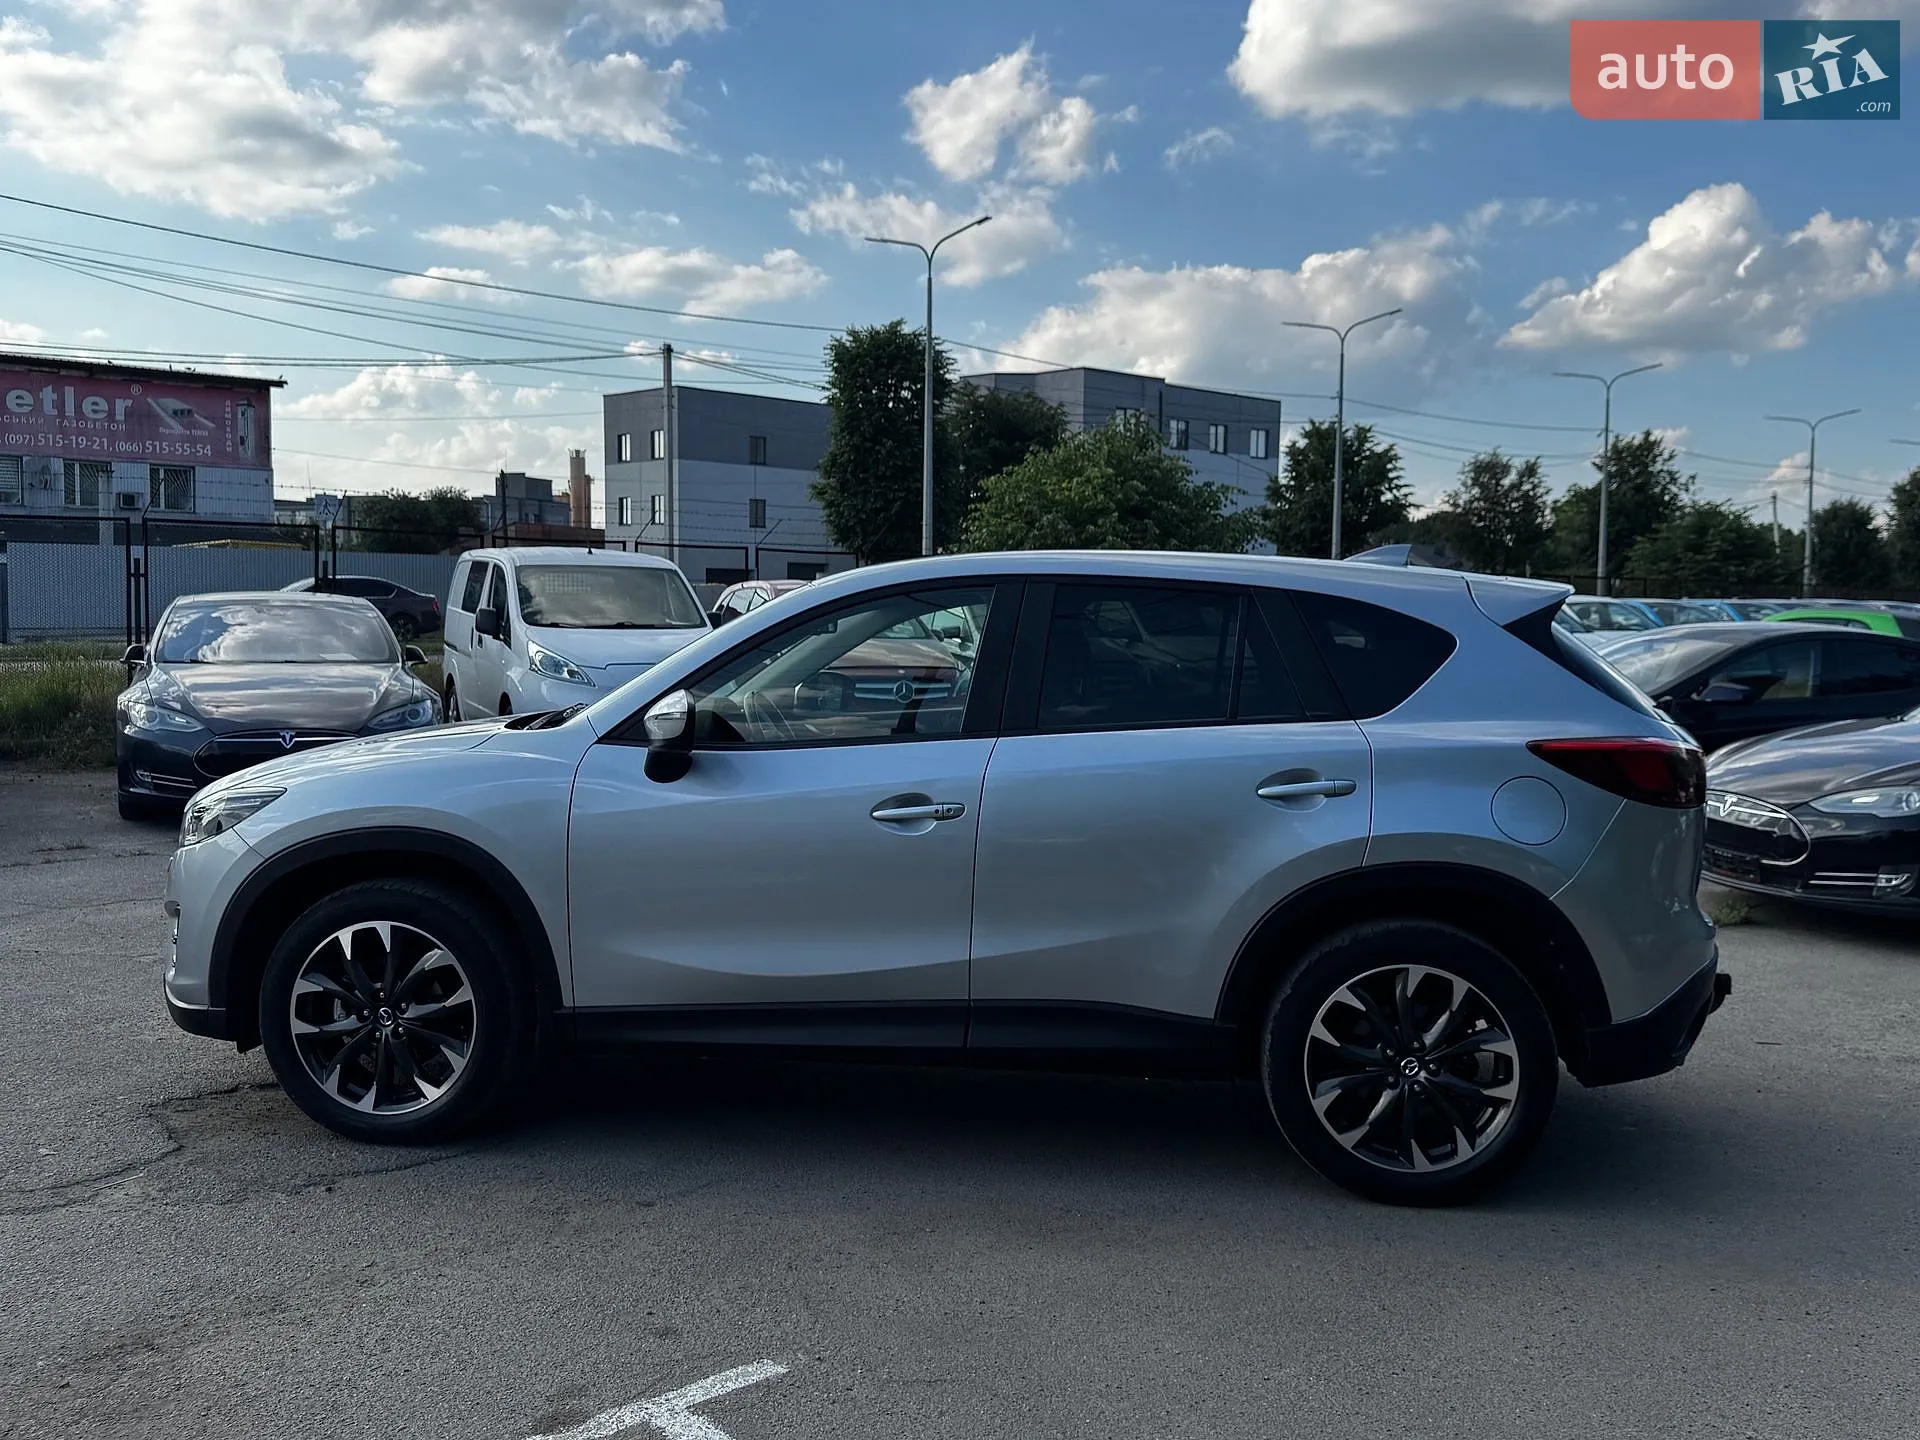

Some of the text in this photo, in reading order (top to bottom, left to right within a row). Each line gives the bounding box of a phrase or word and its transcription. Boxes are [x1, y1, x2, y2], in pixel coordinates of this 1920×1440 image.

[4, 433, 34, 446] (097)
[115, 440, 143, 454] (066)
[145, 440, 212, 457] 515-55-54
